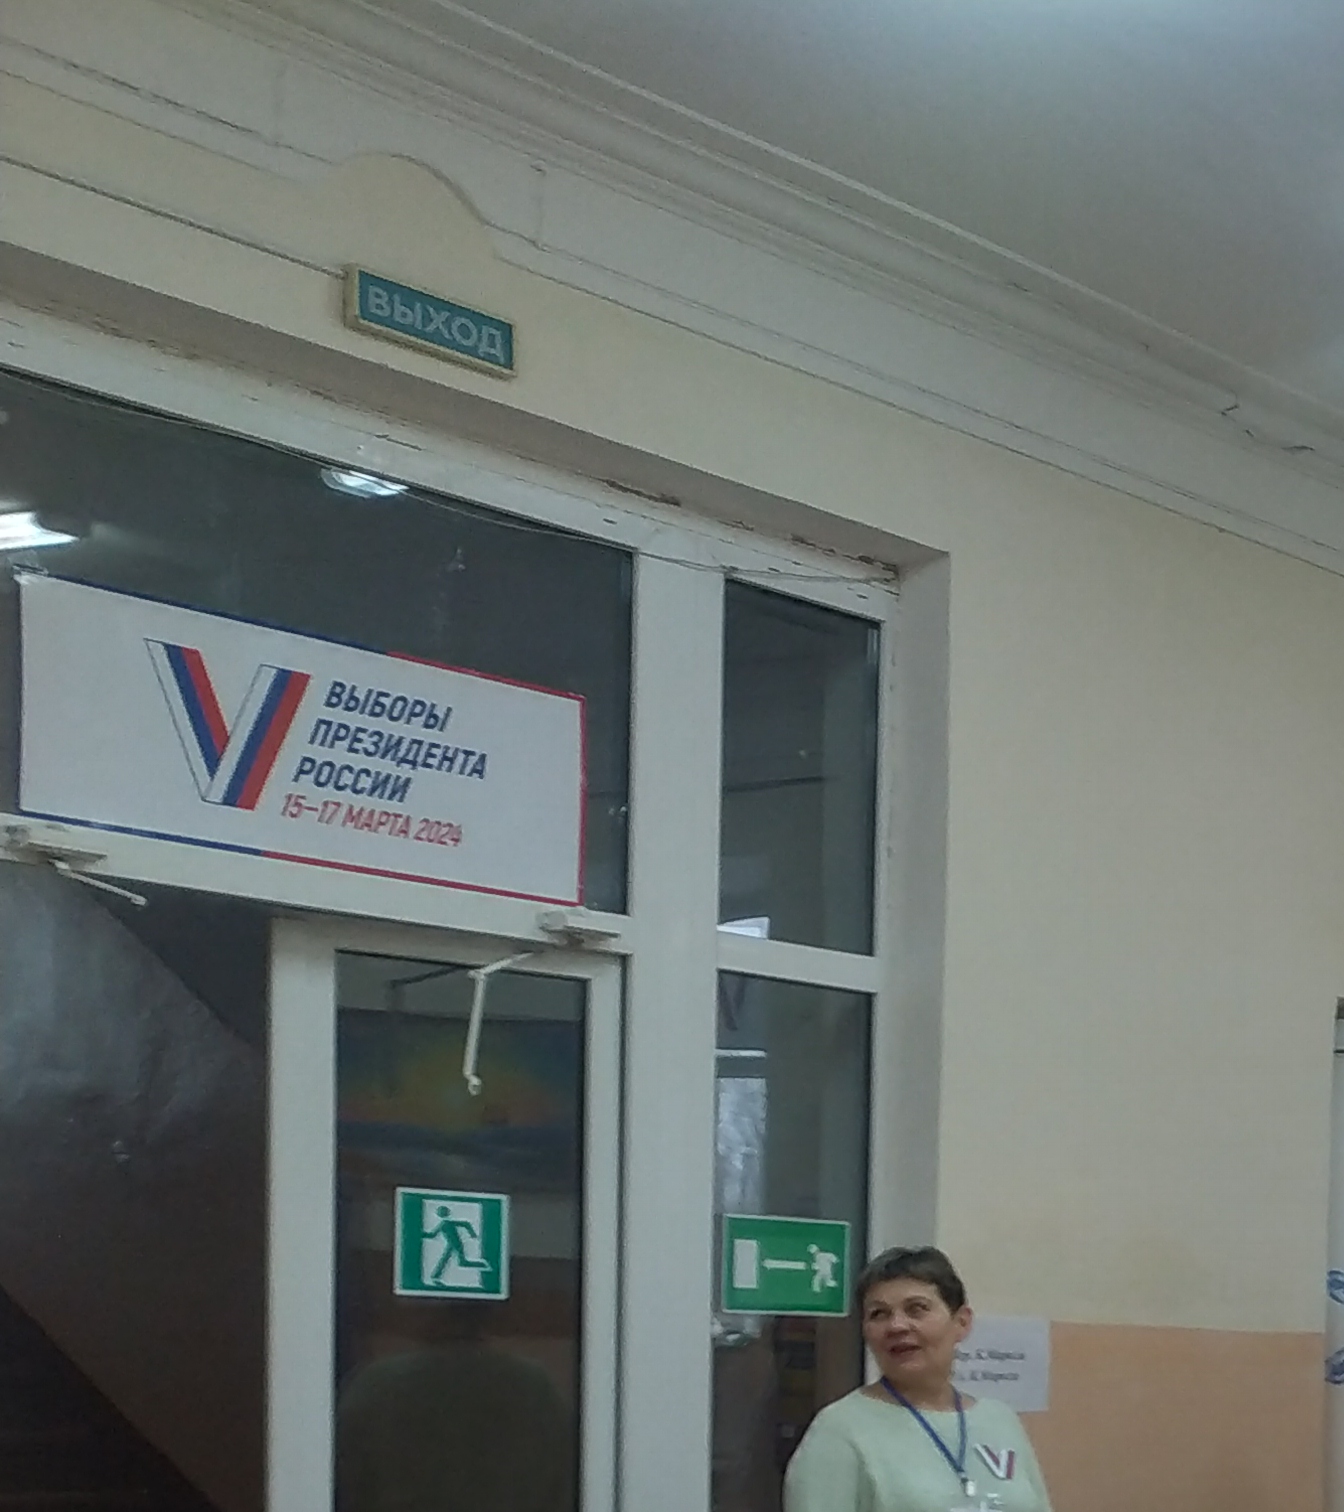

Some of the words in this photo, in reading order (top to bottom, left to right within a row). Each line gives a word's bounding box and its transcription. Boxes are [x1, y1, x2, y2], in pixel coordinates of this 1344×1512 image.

[367, 285, 505, 364] ВЫХОД
[322, 678, 454, 733] ВЫБОРЫ
[306, 717, 488, 780] ПРЕЗИДЕНТА
[291, 755, 413, 803] РОССИИ
[340, 802, 412, 839] МАРТА
[412, 817, 465, 848] 2024
